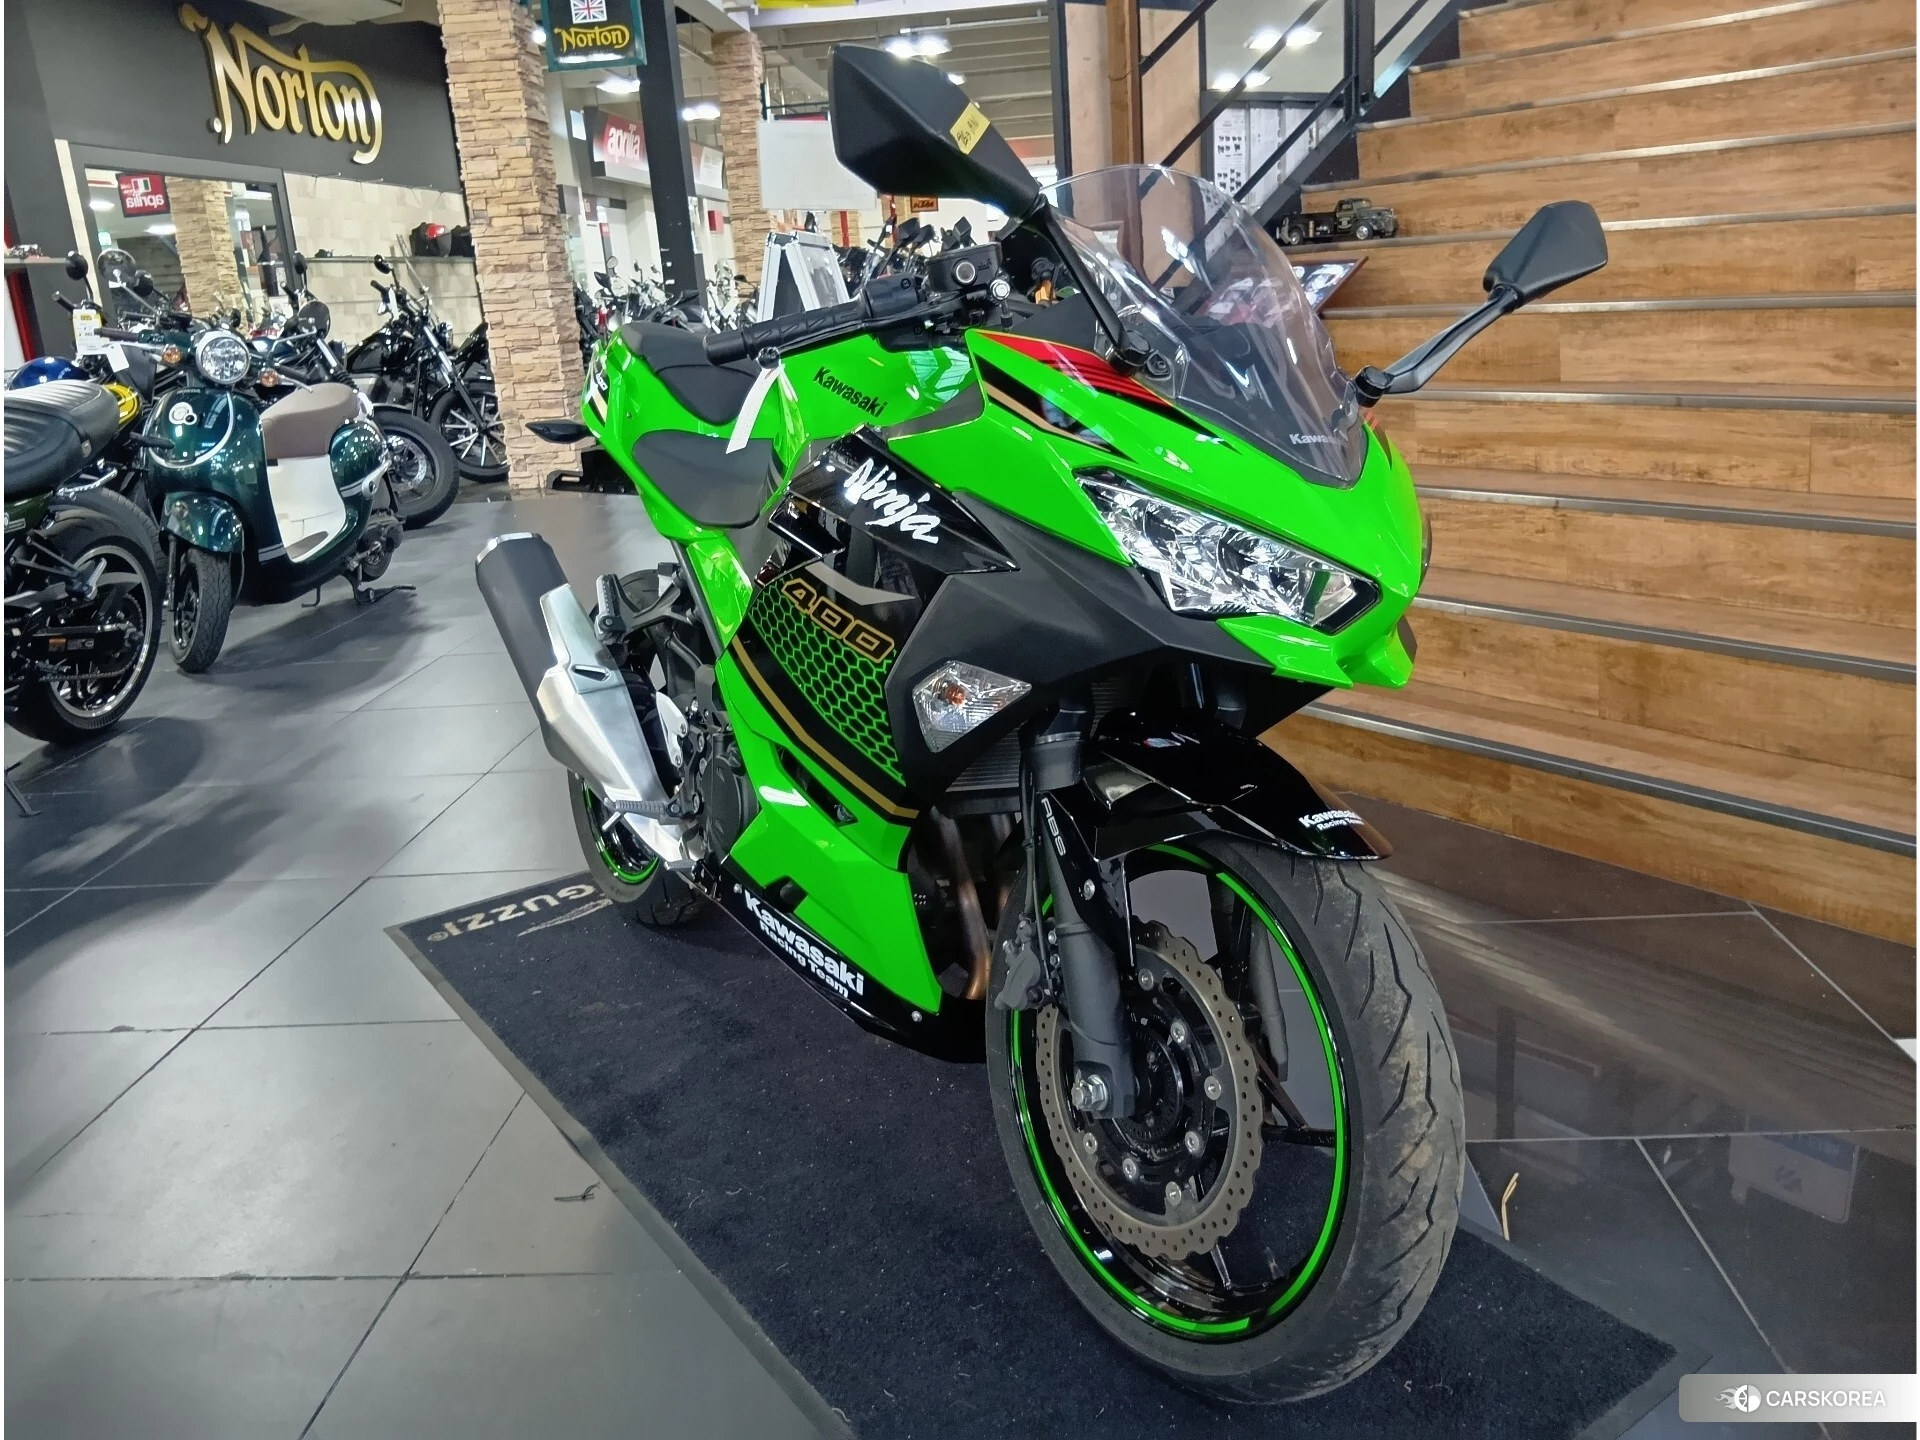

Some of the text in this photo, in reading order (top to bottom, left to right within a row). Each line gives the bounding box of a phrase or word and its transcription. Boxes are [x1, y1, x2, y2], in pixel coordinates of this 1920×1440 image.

[553, 25, 630, 53] Norton
[180, 3, 383, 164] Norton
[607, 124, 641, 164] aprilia
[813, 366, 888, 418] Kawasaki
[843, 457, 941, 545] Ninja
[781, 577, 895, 664] 400
[1041, 797, 1067, 857] ABS
[1316, 820, 1348, 831] Racing
[744, 889, 865, 997] Kawasaki
[759, 919, 850, 998] Racing Team
